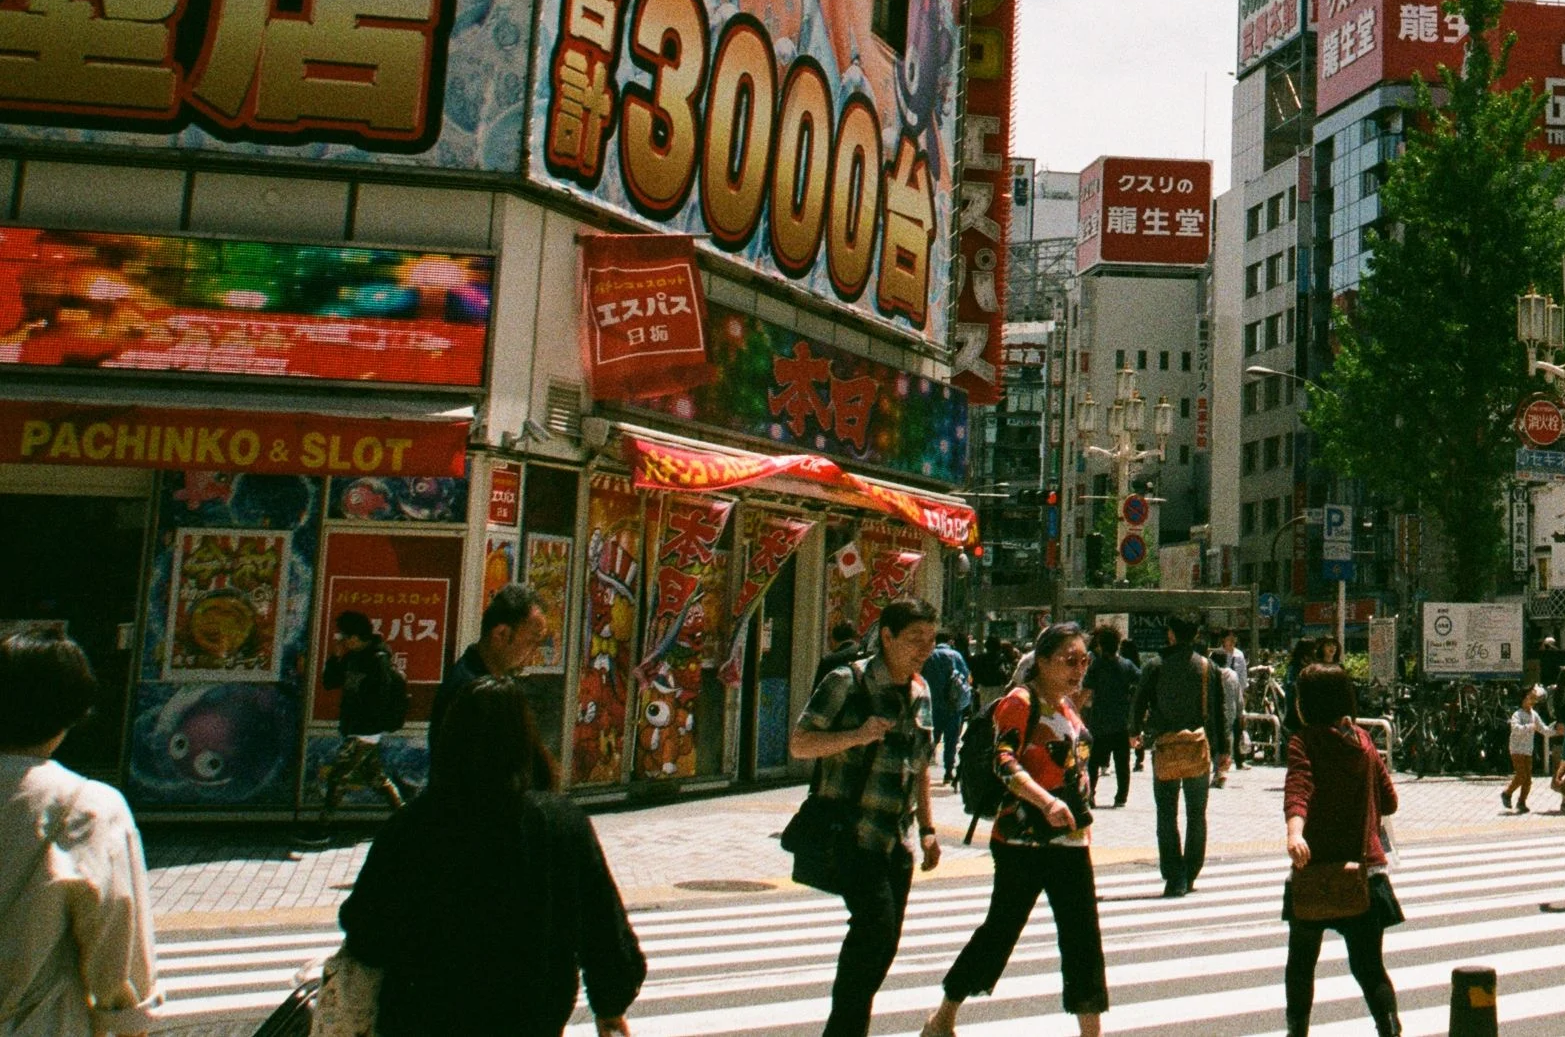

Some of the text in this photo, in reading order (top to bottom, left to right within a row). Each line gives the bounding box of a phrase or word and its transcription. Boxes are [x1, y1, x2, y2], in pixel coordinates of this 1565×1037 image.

[1322, 6, 1377, 80] 龍生堂
[1117, 174, 1194, 194] クスリの
[1106, 206, 1205, 237] 龍生堂
[596, 291, 693, 328] エスパス
[767, 339, 881, 451] 本日
[1527, 412, 1561, 432] 消火栓
[20, 419, 413, 473] PACHINKO & SLOT
